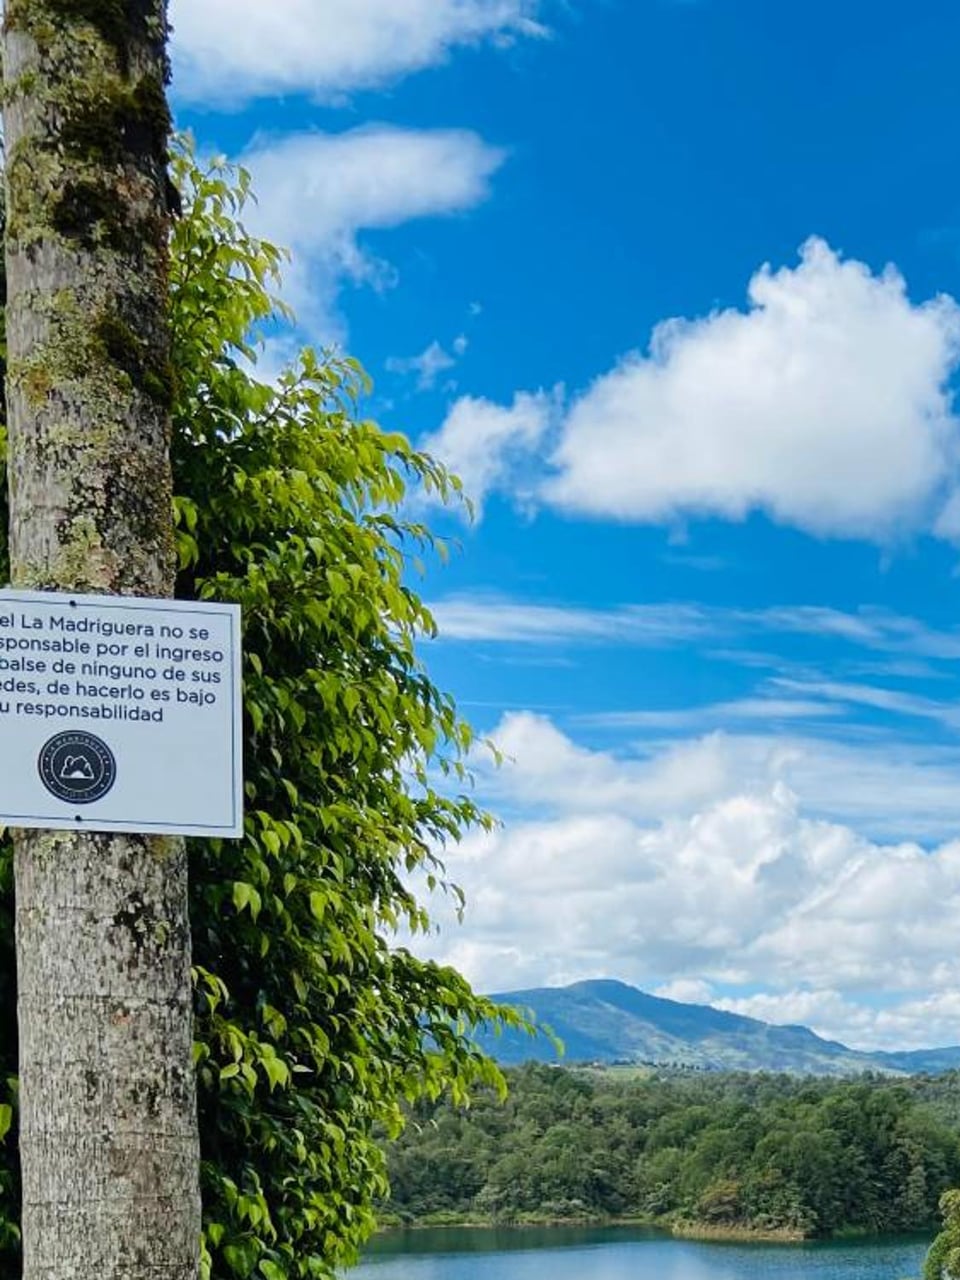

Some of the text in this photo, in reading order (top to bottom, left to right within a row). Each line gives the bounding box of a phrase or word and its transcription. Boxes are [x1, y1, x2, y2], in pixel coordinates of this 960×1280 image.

[21, 614, 43, 629] La
[49, 615, 154, 638] Madriguera
[160, 626, 184, 639] no
[189, 627, 209, 640] se
[96, 643, 129, 658] por
[134, 643, 149, 658] el
[156, 643, 224, 662] ingreso
[52, 660, 75, 674] de
[81, 661, 156, 680] ninguno
[162, 666, 185, 681] de
[191, 670, 221, 683] sus
[47, 680, 70, 695] de
[76, 680, 145, 700] hacerlo
[150, 688, 170, 701] es
[176, 687, 216, 706] bajo
[16, 701, 163, 722] responsabilidad
